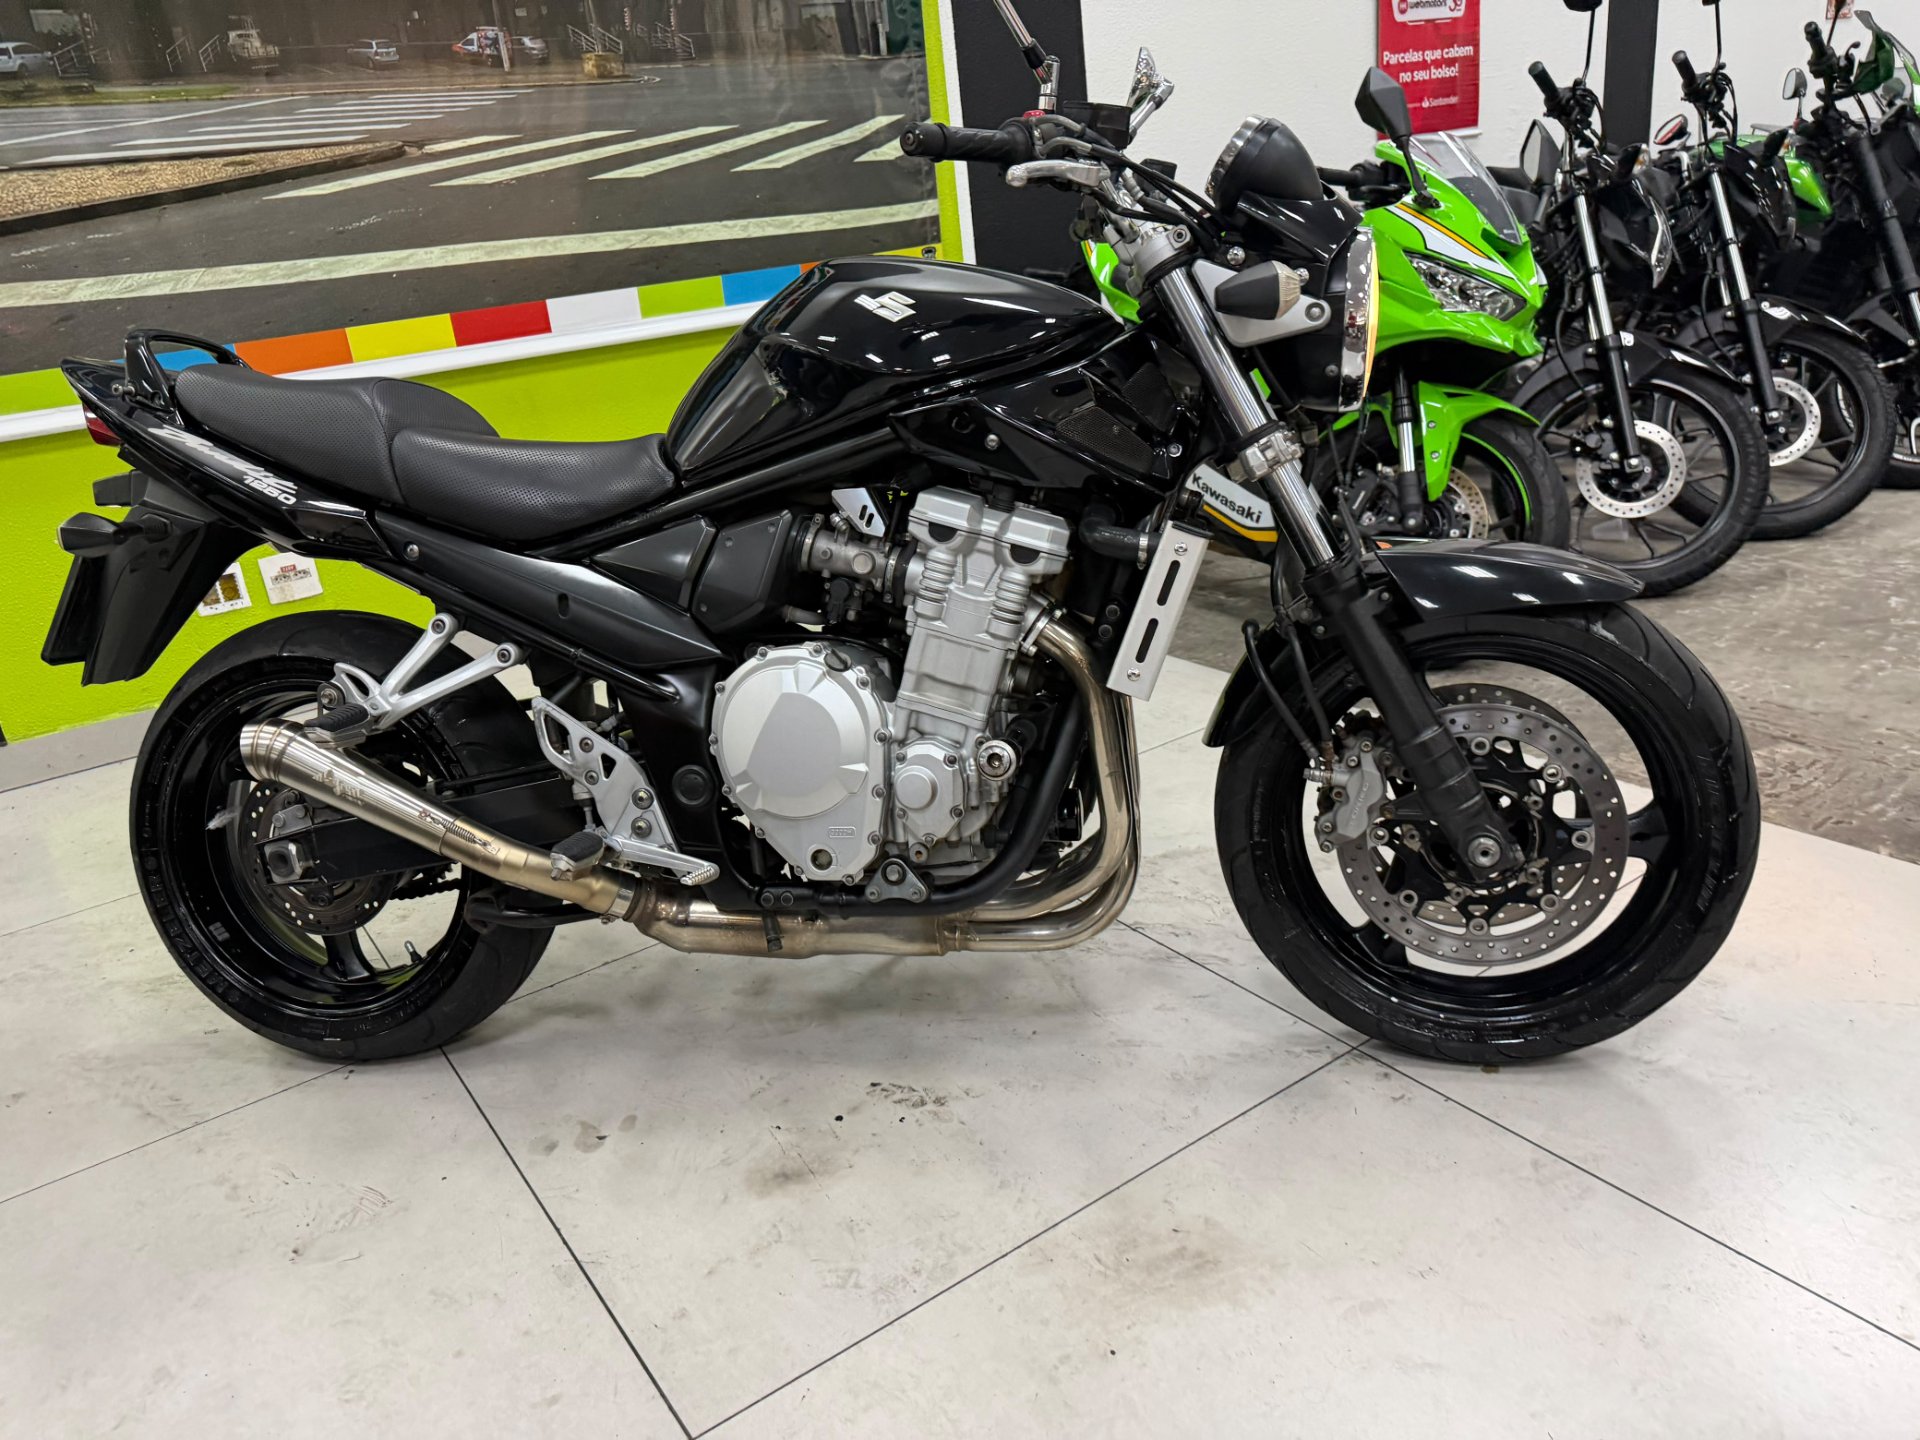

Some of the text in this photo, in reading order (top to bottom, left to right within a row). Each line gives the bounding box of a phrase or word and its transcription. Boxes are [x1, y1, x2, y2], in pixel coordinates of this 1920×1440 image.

[1383, 44, 1473, 65] Parcelas que cabem
[1400, 63, 1459, 83] no seu bolso!
[1429, 96, 1458, 107] Santander
[1192, 473, 1263, 524] Kawasaki
